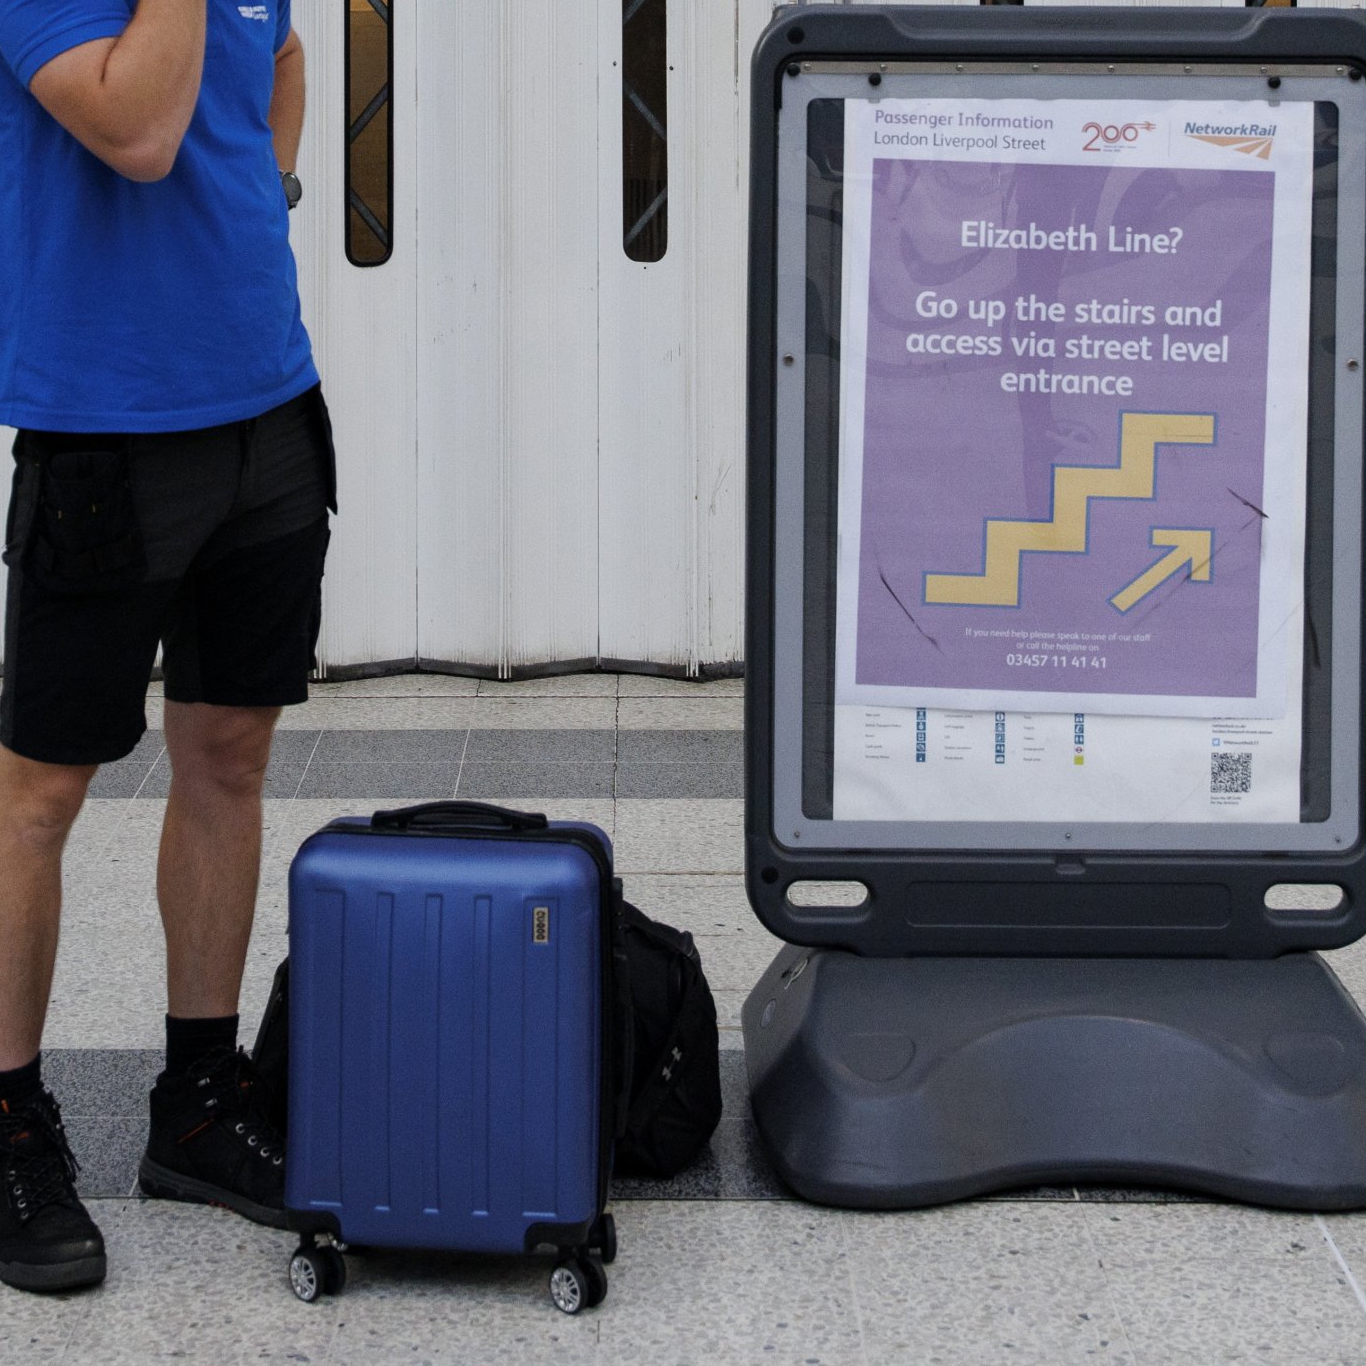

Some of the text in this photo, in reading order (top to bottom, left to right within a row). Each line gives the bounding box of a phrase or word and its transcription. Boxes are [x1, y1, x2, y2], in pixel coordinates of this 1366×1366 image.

[876, 110, 1053, 129] Passenger Information
[1082, 122, 1138, 152] 200
[1185, 122, 1277, 137] NetworkRail
[875, 131, 1045, 150] London Liverpool Street
[962, 221, 1183, 253] Elizabeth Line?
[916, 291, 1221, 329] Go up the stairs and
[906, 332, 1228, 362] access via street level
[1001, 369, 1133, 395] entrance
[973, 629, 988, 637] you
[990, 629, 1009, 638] need
[1011, 630, 1028, 639] help
[1030, 630, 1055, 639] please
[1057, 632, 1079, 641] speak
[1108, 633, 1117, 641] of
[1133, 634, 1150, 642] staff
[1026, 641, 1039, 649] call
[1041, 642, 1054, 650] the
[1057, 643, 1086, 652] helpline
[1006, 654, 1106, 668] 03457 11 41 41
